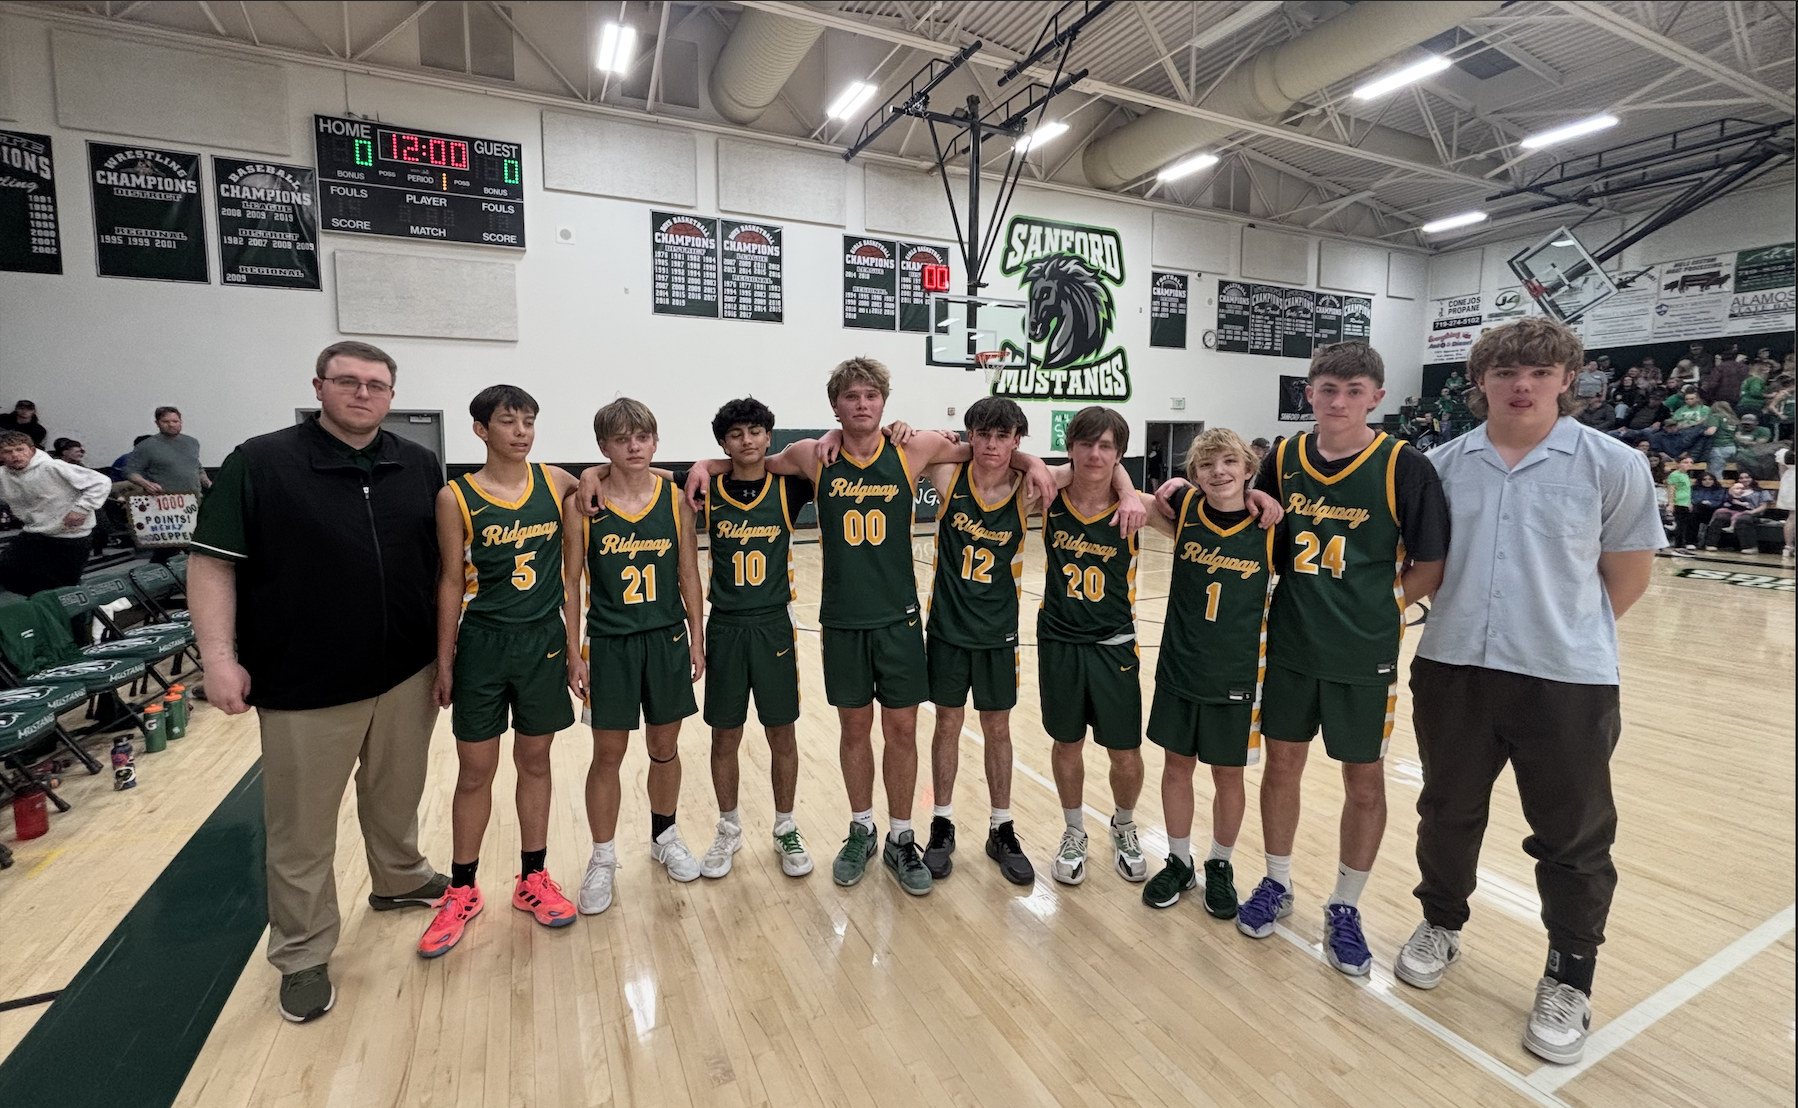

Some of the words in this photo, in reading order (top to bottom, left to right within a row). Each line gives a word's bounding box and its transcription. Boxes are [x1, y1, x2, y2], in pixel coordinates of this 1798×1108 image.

[319, 118, 372, 139] HOME
[355, 139, 372, 166] 0
[392, 133, 467, 168] 12:00
[474, 140, 518, 158] GUEST
[104, 150, 187, 178] WRESTLING
[504, 159, 519, 184] 0
[96, 170, 197, 193] CHAMPIONS
[228, 165, 300, 190] BASEBALL
[337, 170, 365, 180] BONUS
[379, 170, 396, 178] POSS
[407, 174, 434, 184] PERIOD
[442, 172, 447, 191] 1
[454, 179, 470, 187] POSS
[114, 187, 182, 201] DISTRICT
[220, 184, 311, 205] CHAMPIONS
[330, 186, 368, 198] FOULS
[483, 187, 508, 196] BONUS
[242, 201, 292, 212] LEAGUE
[406, 194, 447, 206] PLAYER
[221, 208, 241, 217] 2008
[246, 210, 266, 219] 2009
[274, 213, 293, 222] 2019
[482, 203, 515, 214] FOULS
[331, 218, 371, 230] SCORE
[410, 226, 446, 237] MATCH
[672, 217, 709, 237] BASKETBALL
[114, 227, 188, 240] REGIONAL
[224, 236, 244, 245] 1982
[248, 238, 268, 247] 2007
[239, 228, 299, 241] DISTRICT
[482, 233, 517, 243] SCORE
[655, 232, 715, 249] CHAMPIONS
[740, 225, 774, 245] BASKETBALL
[32, 238, 55, 246] 2001
[32, 246, 57, 254] 2002
[101, 235, 123, 244] 1995
[155, 239, 176, 249] 2001
[724, 240, 779, 256] CHAMPIONS
[863, 240, 890, 258] BASKETBALL
[1006, 223, 1121, 281] SANFORD
[846, 254, 894, 269] CHAMPIONS
[226, 273, 246, 282] 2009
[239, 266, 304, 277] REGIONAL
[925, 266, 948, 289] 00
[1156, 275, 1183, 289] FOOTBALL
[1223, 283, 1247, 296] VOLLEYBALL
[1153, 287, 1186, 298] CHAMPIONS
[1220, 295, 1249, 305] CHAMPIONS
[1448, 297, 1481, 307] CONEJOS
[1448, 304, 1480, 315] PROPANE
[1316, 306, 1341, 315] CHAMPIONS
[996, 348, 1127, 396] MUSTANGS
[828, 477, 899, 504] Ridgway
[157, 495, 184, 510] 1000
[1286, 492, 1370, 530] Ridgway
[145, 515, 191, 524] POINTS!
[843, 508, 887, 546] 00
[482, 519, 559, 549] Ridgway
[716, 520, 782, 545] Ridgway
[950, 512, 1014, 547] Ridgway
[599, 533, 673, 561] Ridgway
[1051, 530, 1118, 563] Ridgway
[1180, 541, 1261, 580] Ridgway
[1294, 531, 1347, 579] 24
[511, 550, 537, 591] 5
[732, 550, 768, 587] 10
[961, 544, 996, 584] 12
[621, 564, 656, 604] 21
[1062, 563, 1106, 602] 20
[1205, 581, 1222, 622] 1
